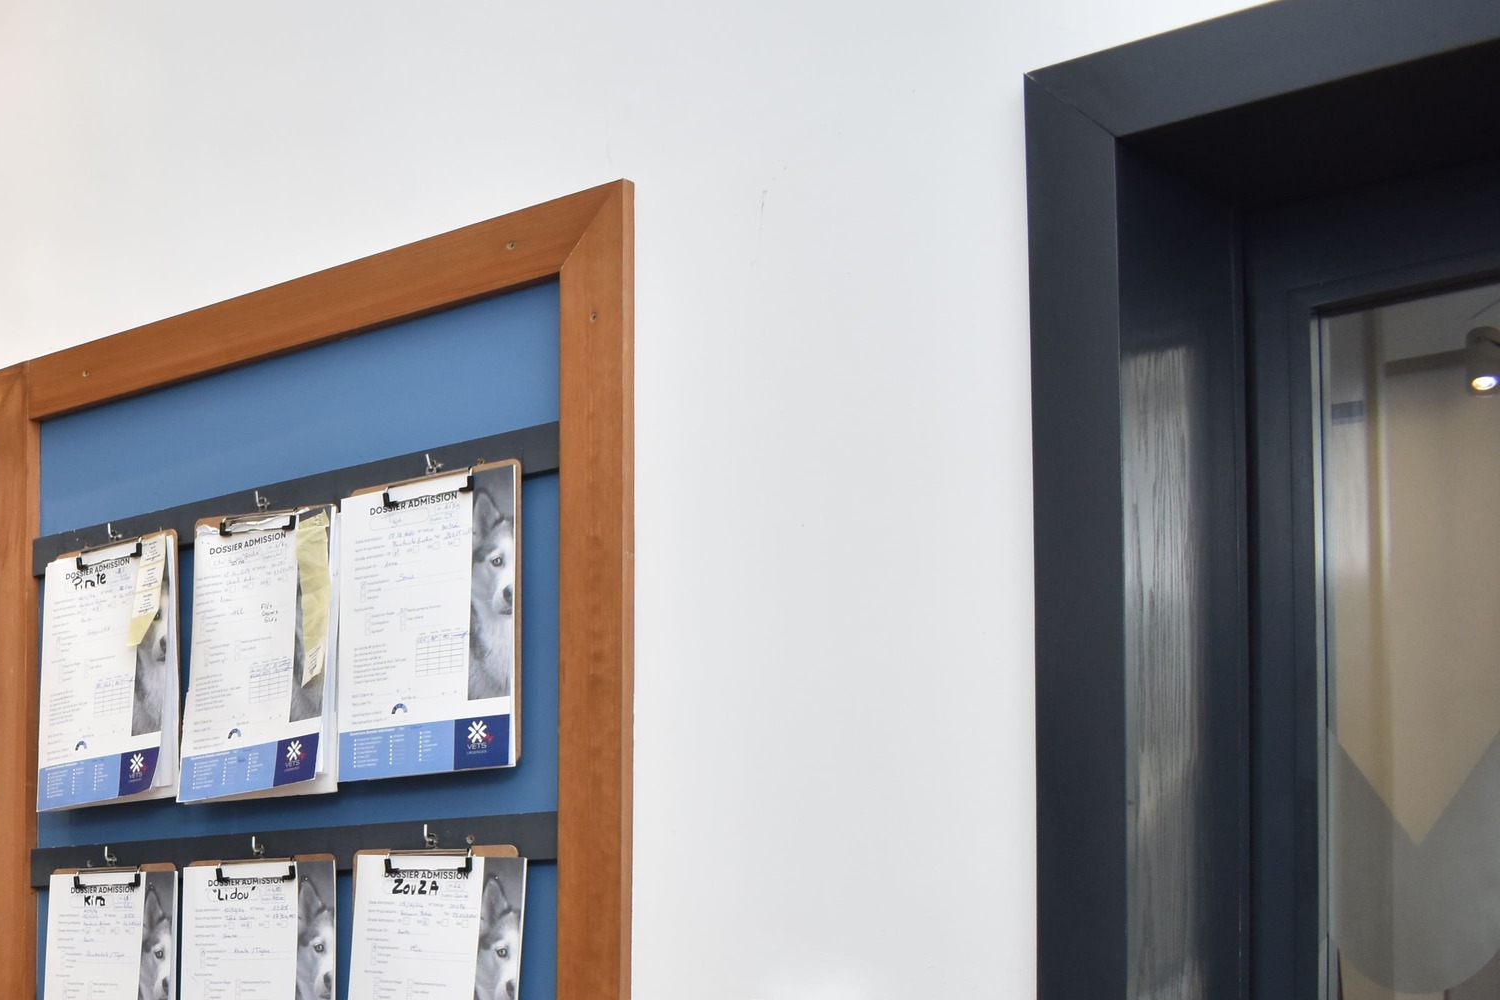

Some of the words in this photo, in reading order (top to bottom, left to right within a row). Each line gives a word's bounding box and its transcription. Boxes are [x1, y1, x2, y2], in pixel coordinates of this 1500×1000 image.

[370, 501, 406, 515] DOSSIER
[407, 491, 457, 509] ADMISSION
[209, 542, 243, 555] DOSSIER
[243, 532, 287, 548] ADMISSION
[65, 566, 94, 580] DOSSIER
[94, 558, 130, 573] ADMISSION
[72, 573, 107, 590] Pirate
[467, 742, 487, 750] VETS
[384, 870, 419, 879] DOSSIER
[421, 871, 469, 880] ADMISSION
[207, 879, 240, 887] DOSSIER
[70, 886, 97, 894] DOSSIER
[98, 885, 135, 894] ADMISSION
[83, 895, 106, 907] Kira
